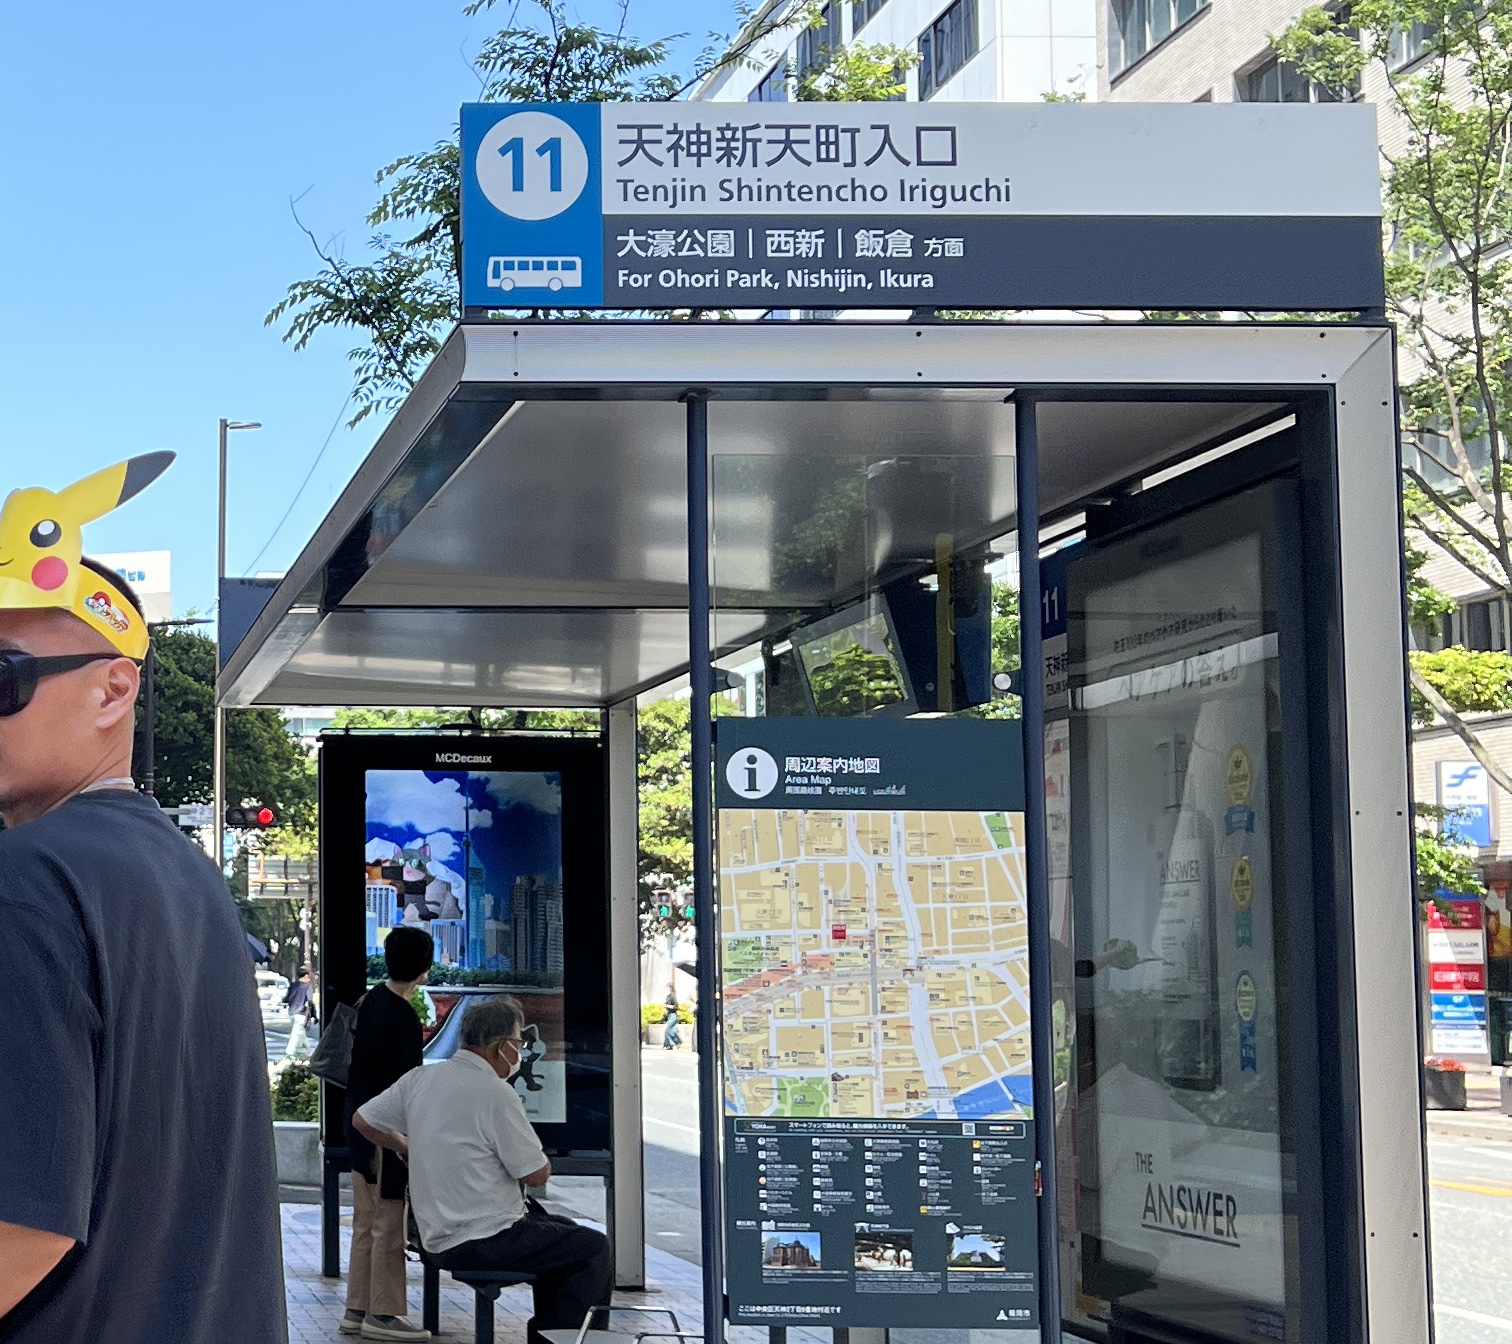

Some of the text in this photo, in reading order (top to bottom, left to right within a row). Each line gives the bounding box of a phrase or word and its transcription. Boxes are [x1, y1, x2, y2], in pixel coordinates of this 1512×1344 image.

[616, 122, 958, 169] 天神新天町入口
[497, 137, 563, 193] 11
[615, 177, 1012, 209] Tenjin Shintencho Iriguchi
[616, 228, 965, 259] 大濠公園 西新 飯倉 方面
[618, 268, 934, 293] For Ohori Park, Nishijin, Ikura
[435, 752, 493, 764] MCDecaux
[784, 756, 881, 774] 周辺案内地図
[785, 775, 832, 787] Area Map
[1134, 1151, 1154, 1175] THE
[1142, 1181, 1239, 1239] ANSWER
